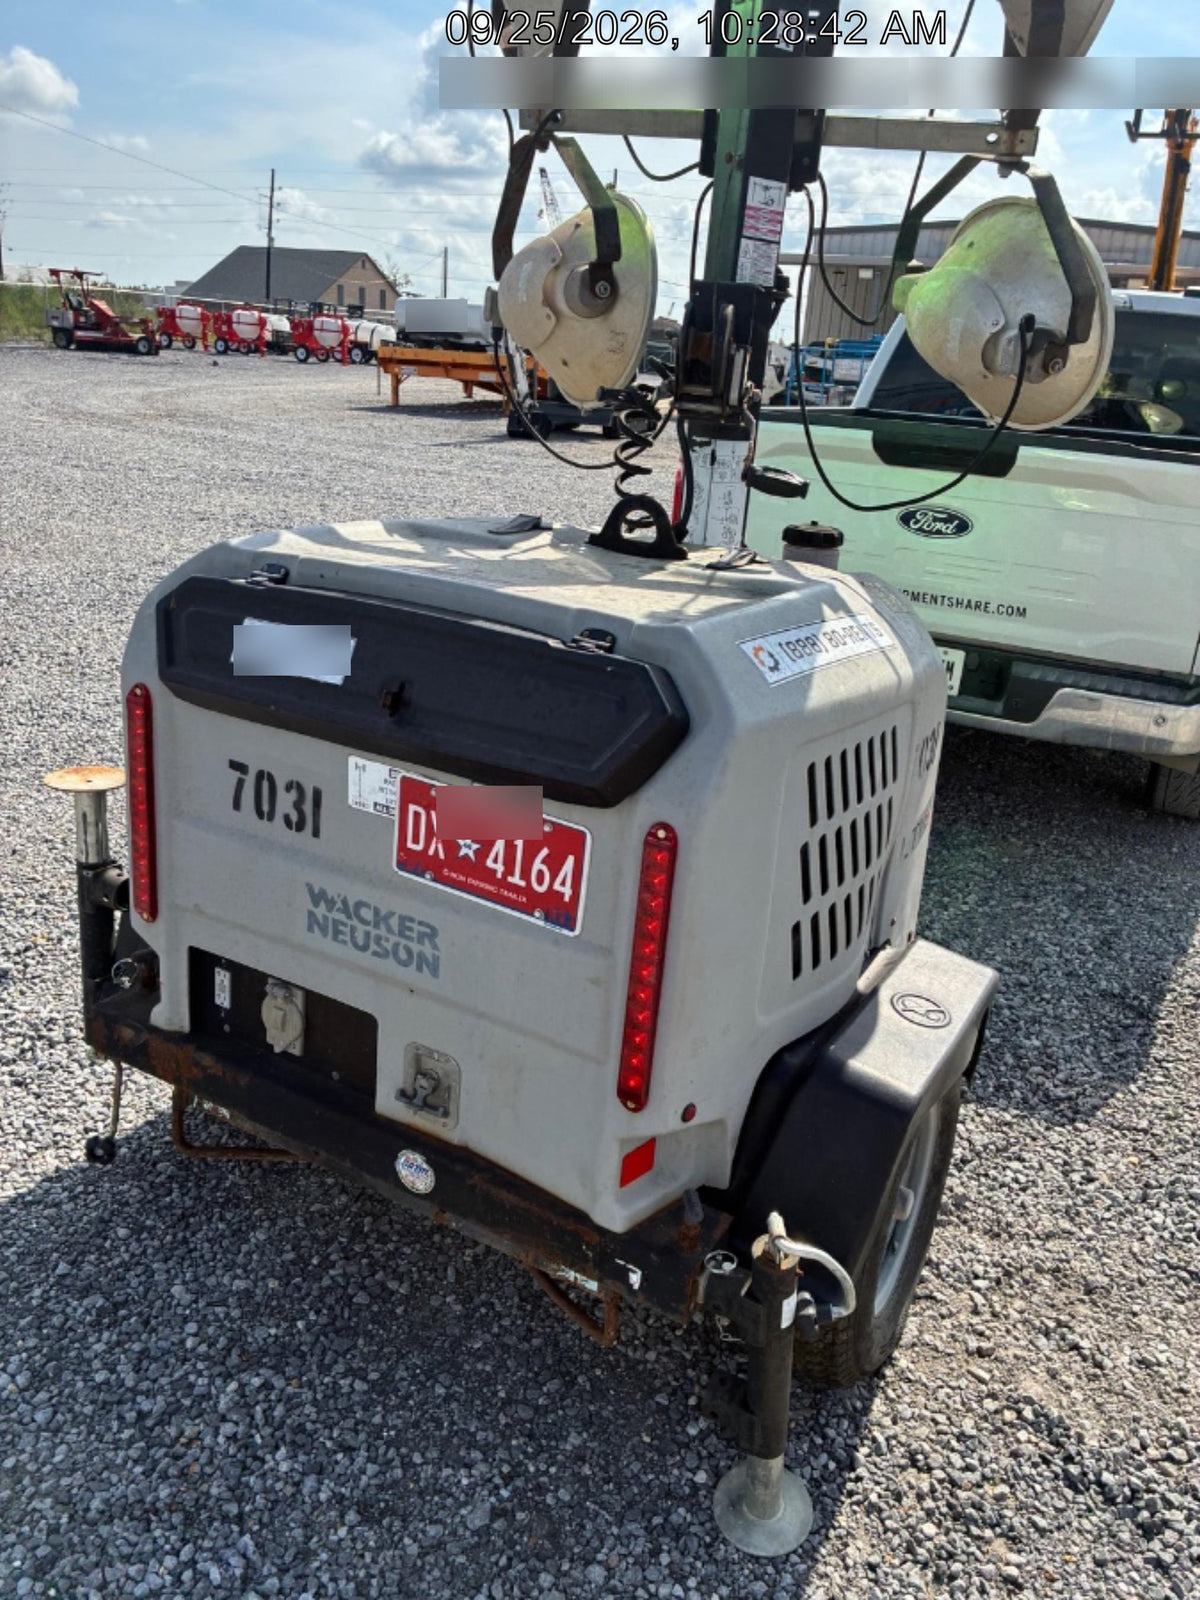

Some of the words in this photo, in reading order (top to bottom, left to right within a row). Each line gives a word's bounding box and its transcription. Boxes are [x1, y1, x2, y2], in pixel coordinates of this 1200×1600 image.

[908, 509, 958, 535] Ford
[900, 588, 1028, 618] PMENTSHARE.COM
[778, 633, 829, 662] (888)
[228, 758, 322, 839] 7031
[406, 803, 445, 860] DX
[485, 839, 575, 903] 4164
[305, 881, 441, 952] WACKER
[306, 908, 441, 979] NEUSON
